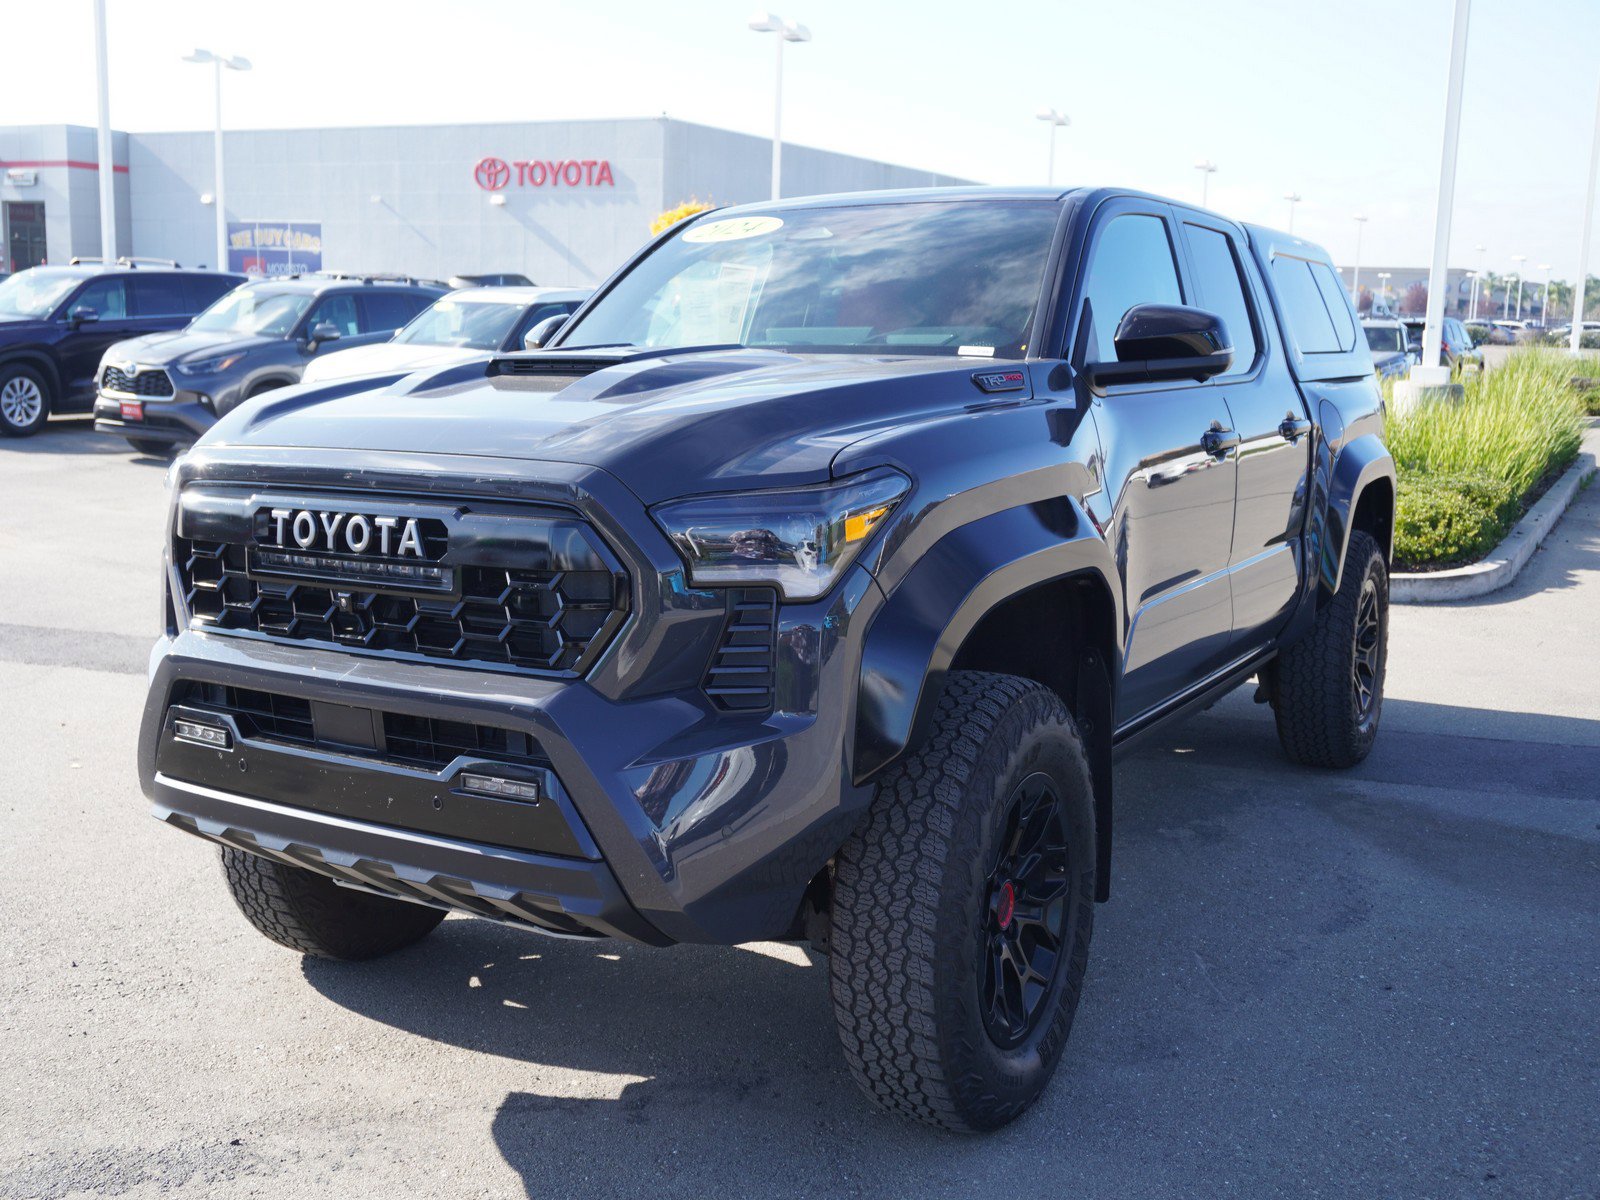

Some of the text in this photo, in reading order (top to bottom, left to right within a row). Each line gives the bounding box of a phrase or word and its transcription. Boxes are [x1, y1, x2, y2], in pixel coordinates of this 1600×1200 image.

[513, 159, 615, 187] TOYOTA
[230, 227, 321, 255] WE BUY CARS
[271, 508, 427, 560] TOYOTA
